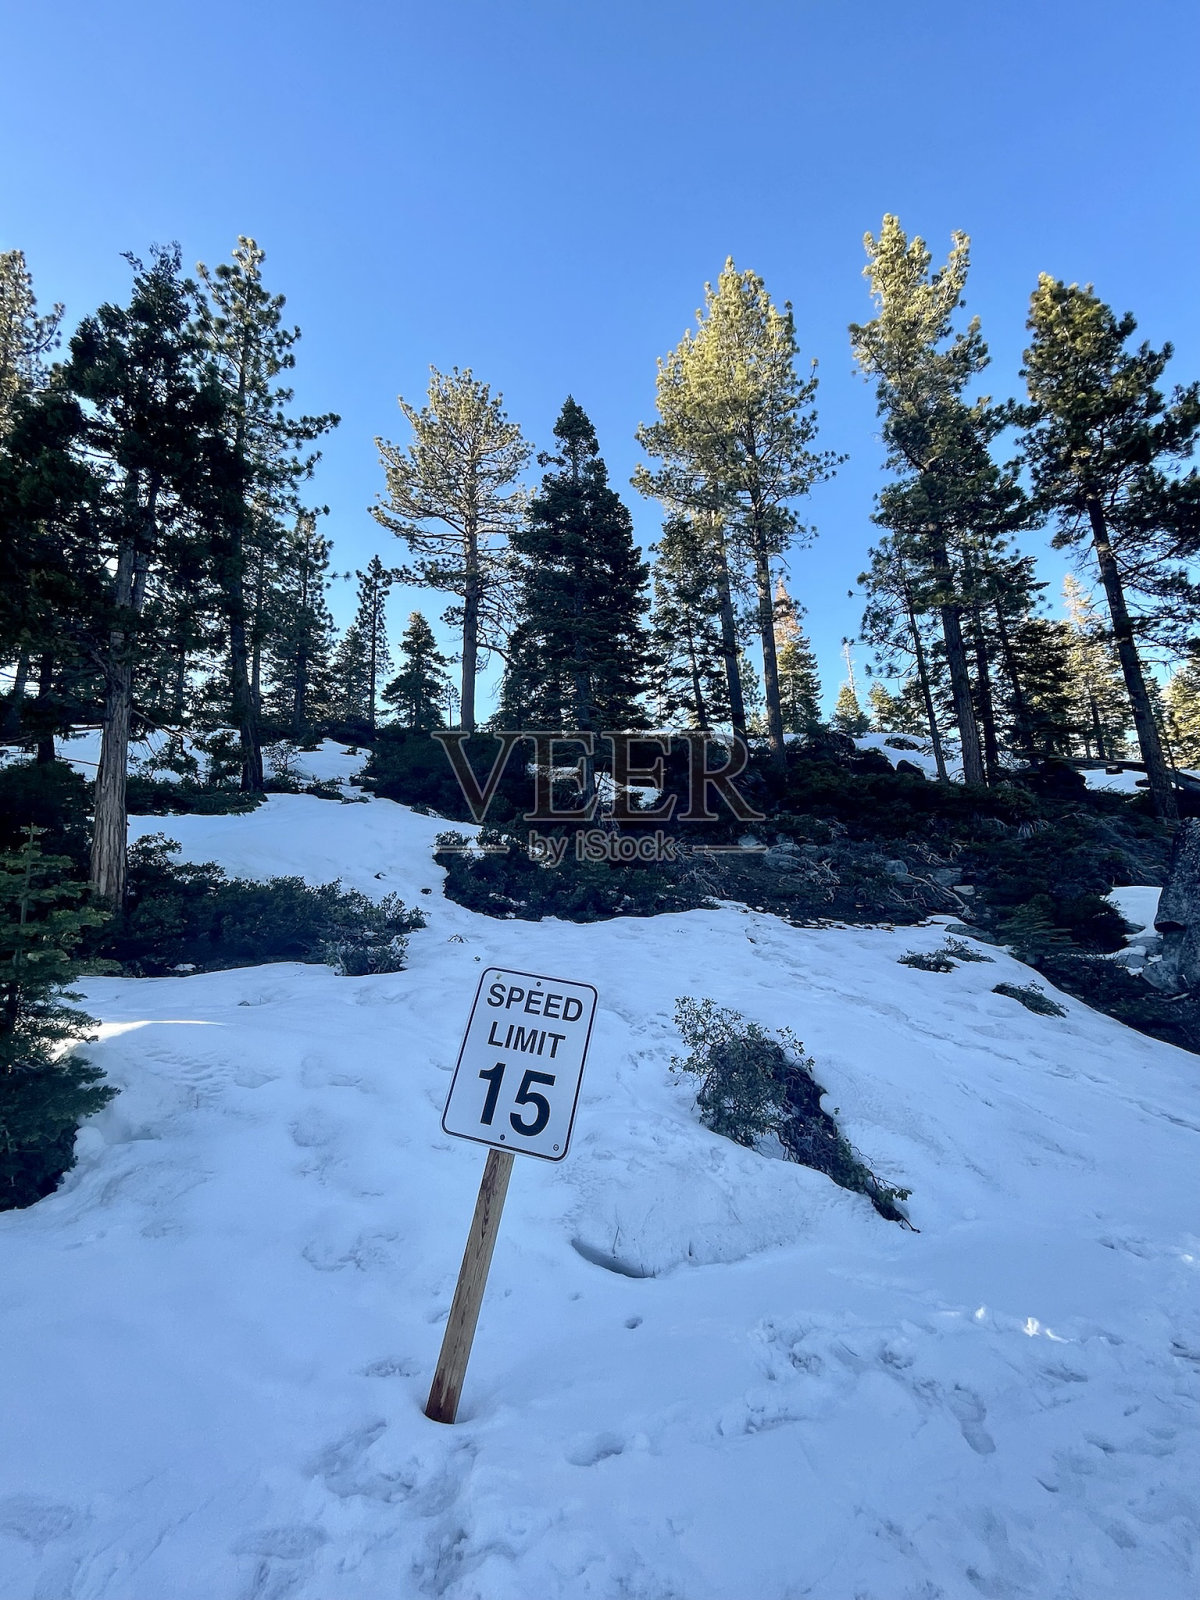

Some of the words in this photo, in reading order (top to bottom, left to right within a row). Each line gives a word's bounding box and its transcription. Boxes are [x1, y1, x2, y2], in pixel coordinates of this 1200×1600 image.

[486, 983, 583, 1022] SPEED
[487, 1021, 566, 1058] LIMIT
[479, 1062, 556, 1137] 15
